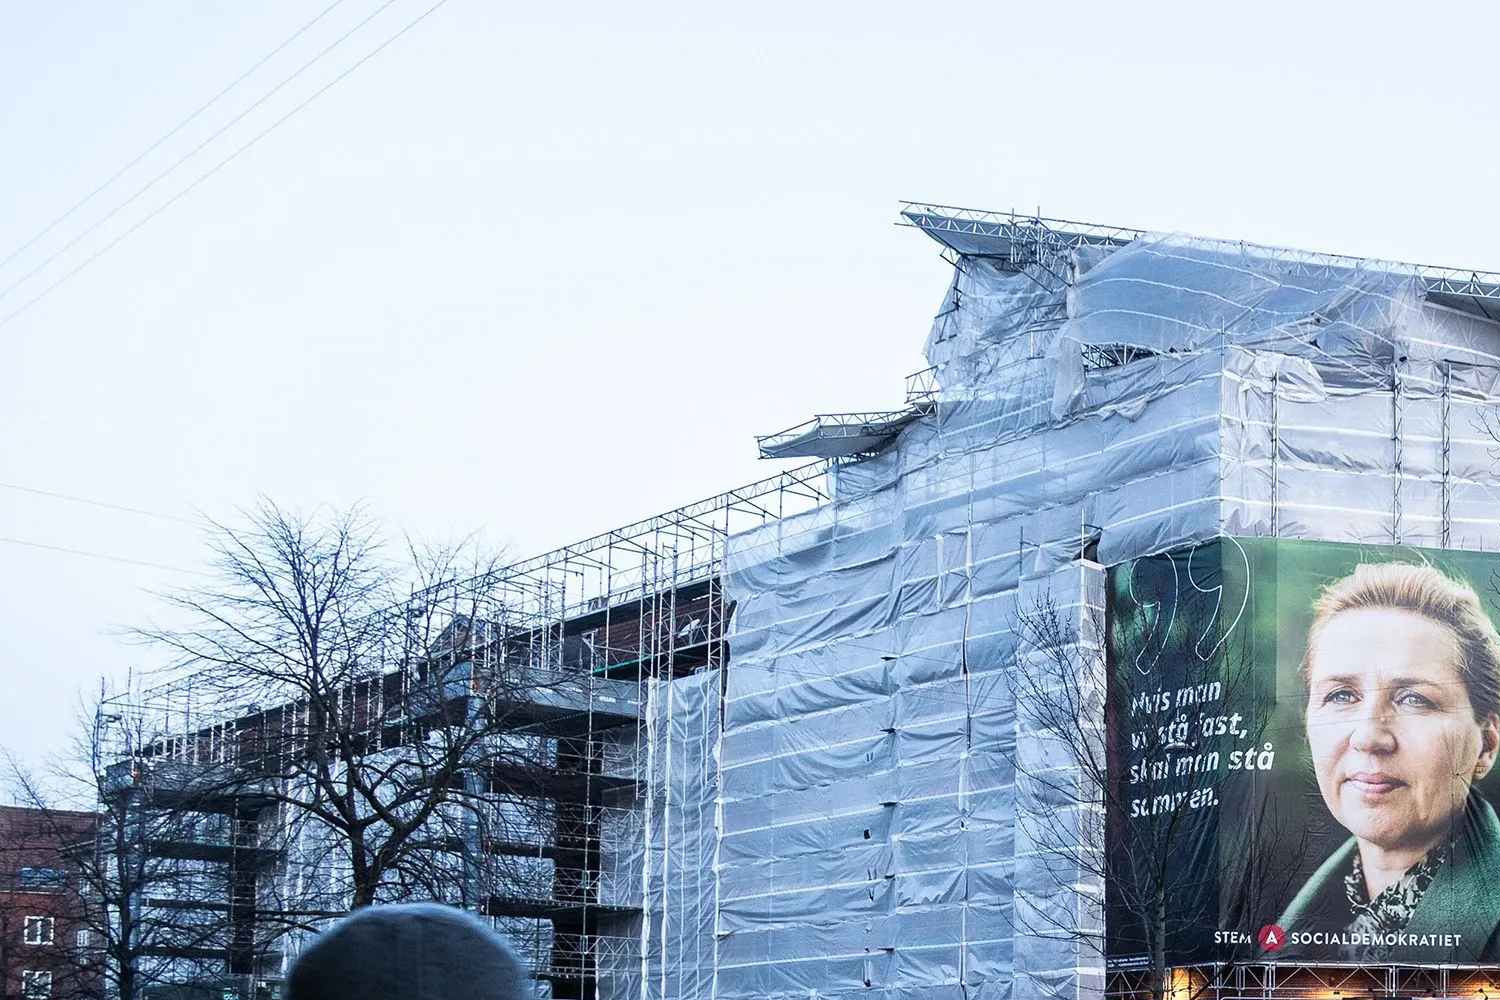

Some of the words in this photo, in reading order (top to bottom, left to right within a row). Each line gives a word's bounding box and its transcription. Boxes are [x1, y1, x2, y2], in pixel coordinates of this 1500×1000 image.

[1175, 681, 1221, 708] man
[1227, 742, 1276, 771] stå
[1214, 930, 1252, 944] STEM
[1265, 930, 1278, 945] A
[1291, 932, 1462, 947] SOCIALDEMOKRATIET
